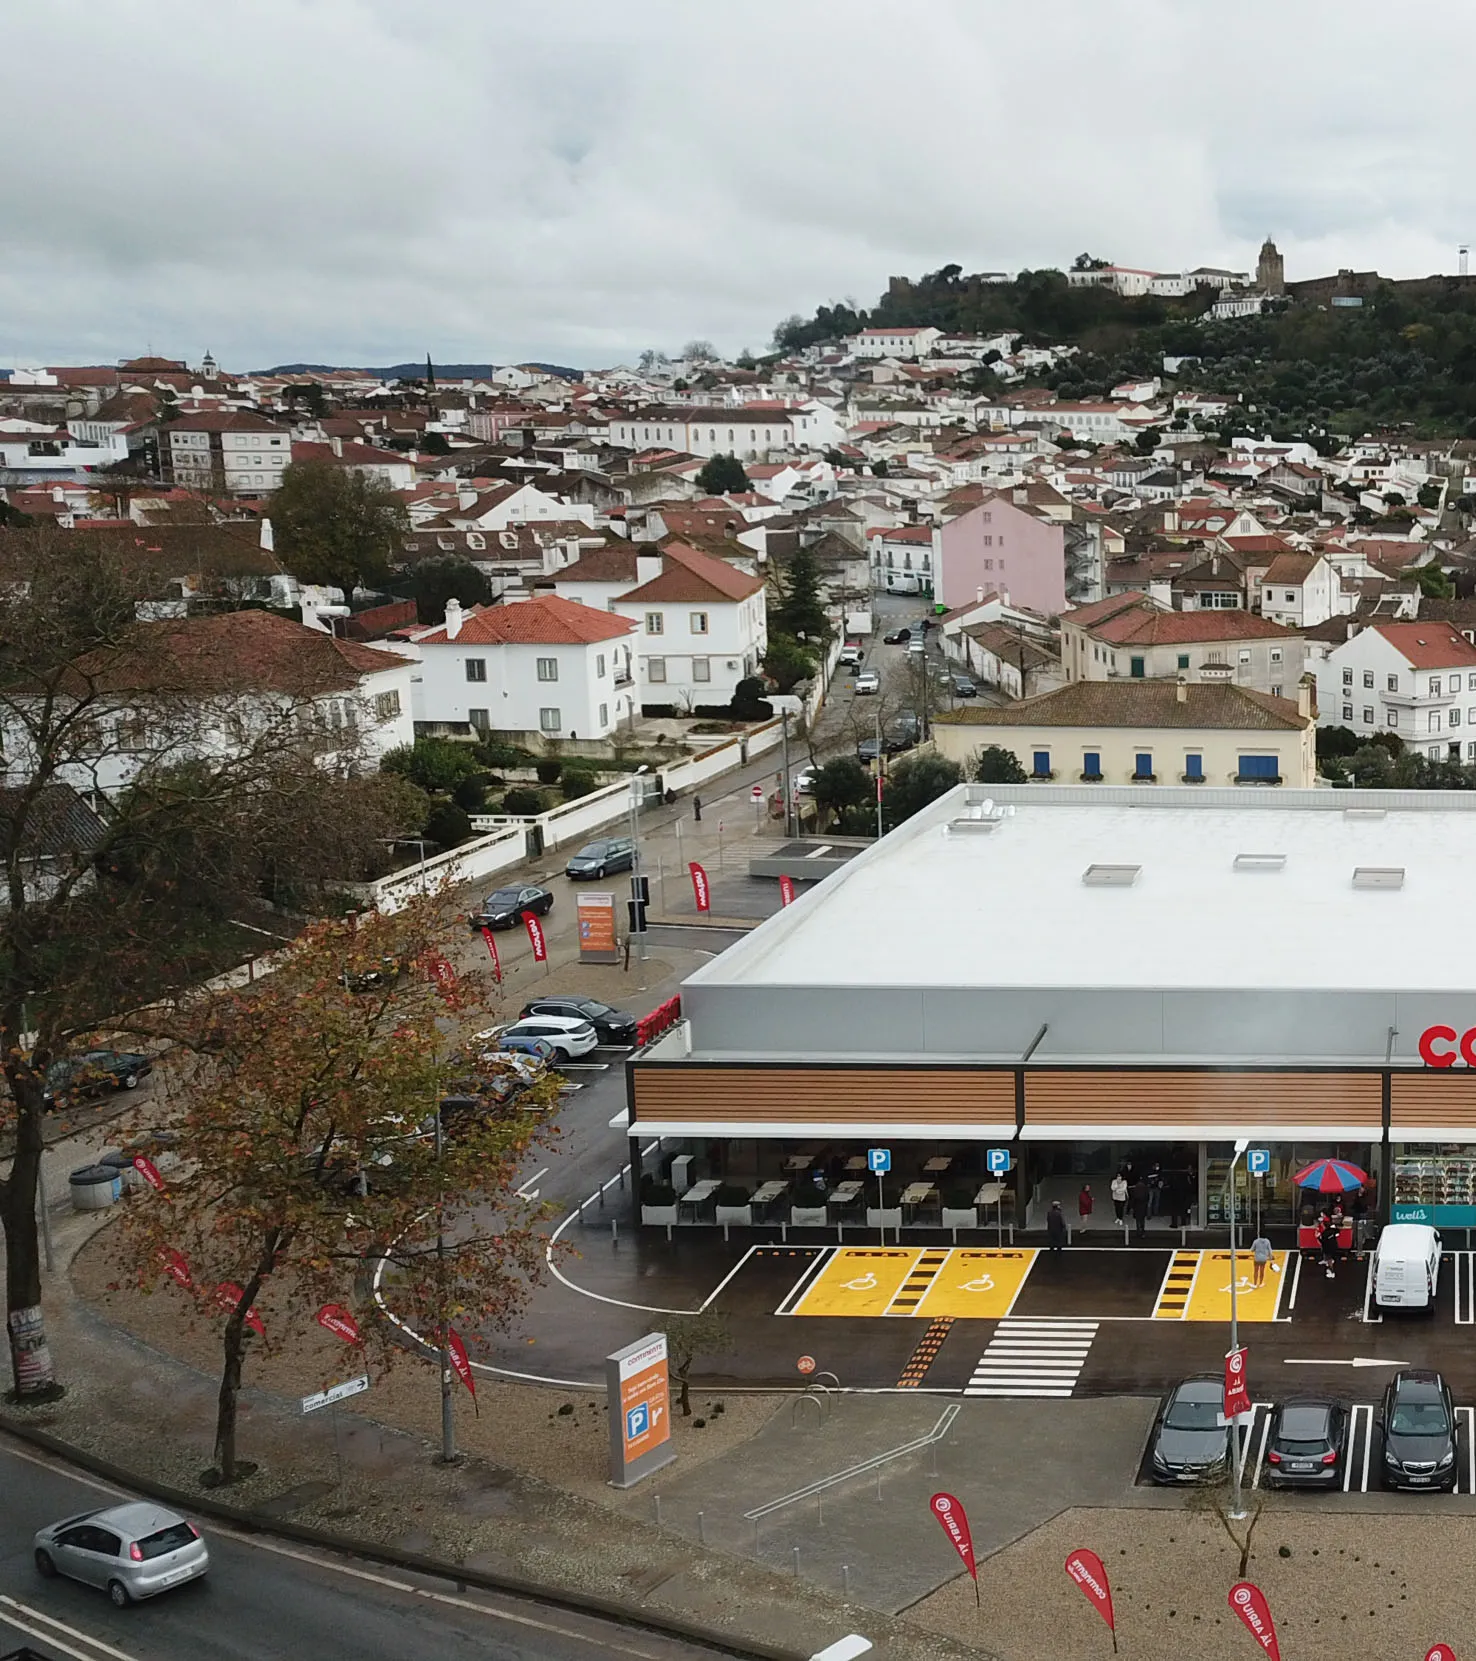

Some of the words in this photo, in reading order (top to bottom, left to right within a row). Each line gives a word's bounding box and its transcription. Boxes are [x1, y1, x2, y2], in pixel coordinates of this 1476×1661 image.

[872, 1151, 886, 1169] P
[991, 1151, 1005, 1170] P
[1251, 1152, 1265, 1170] P
